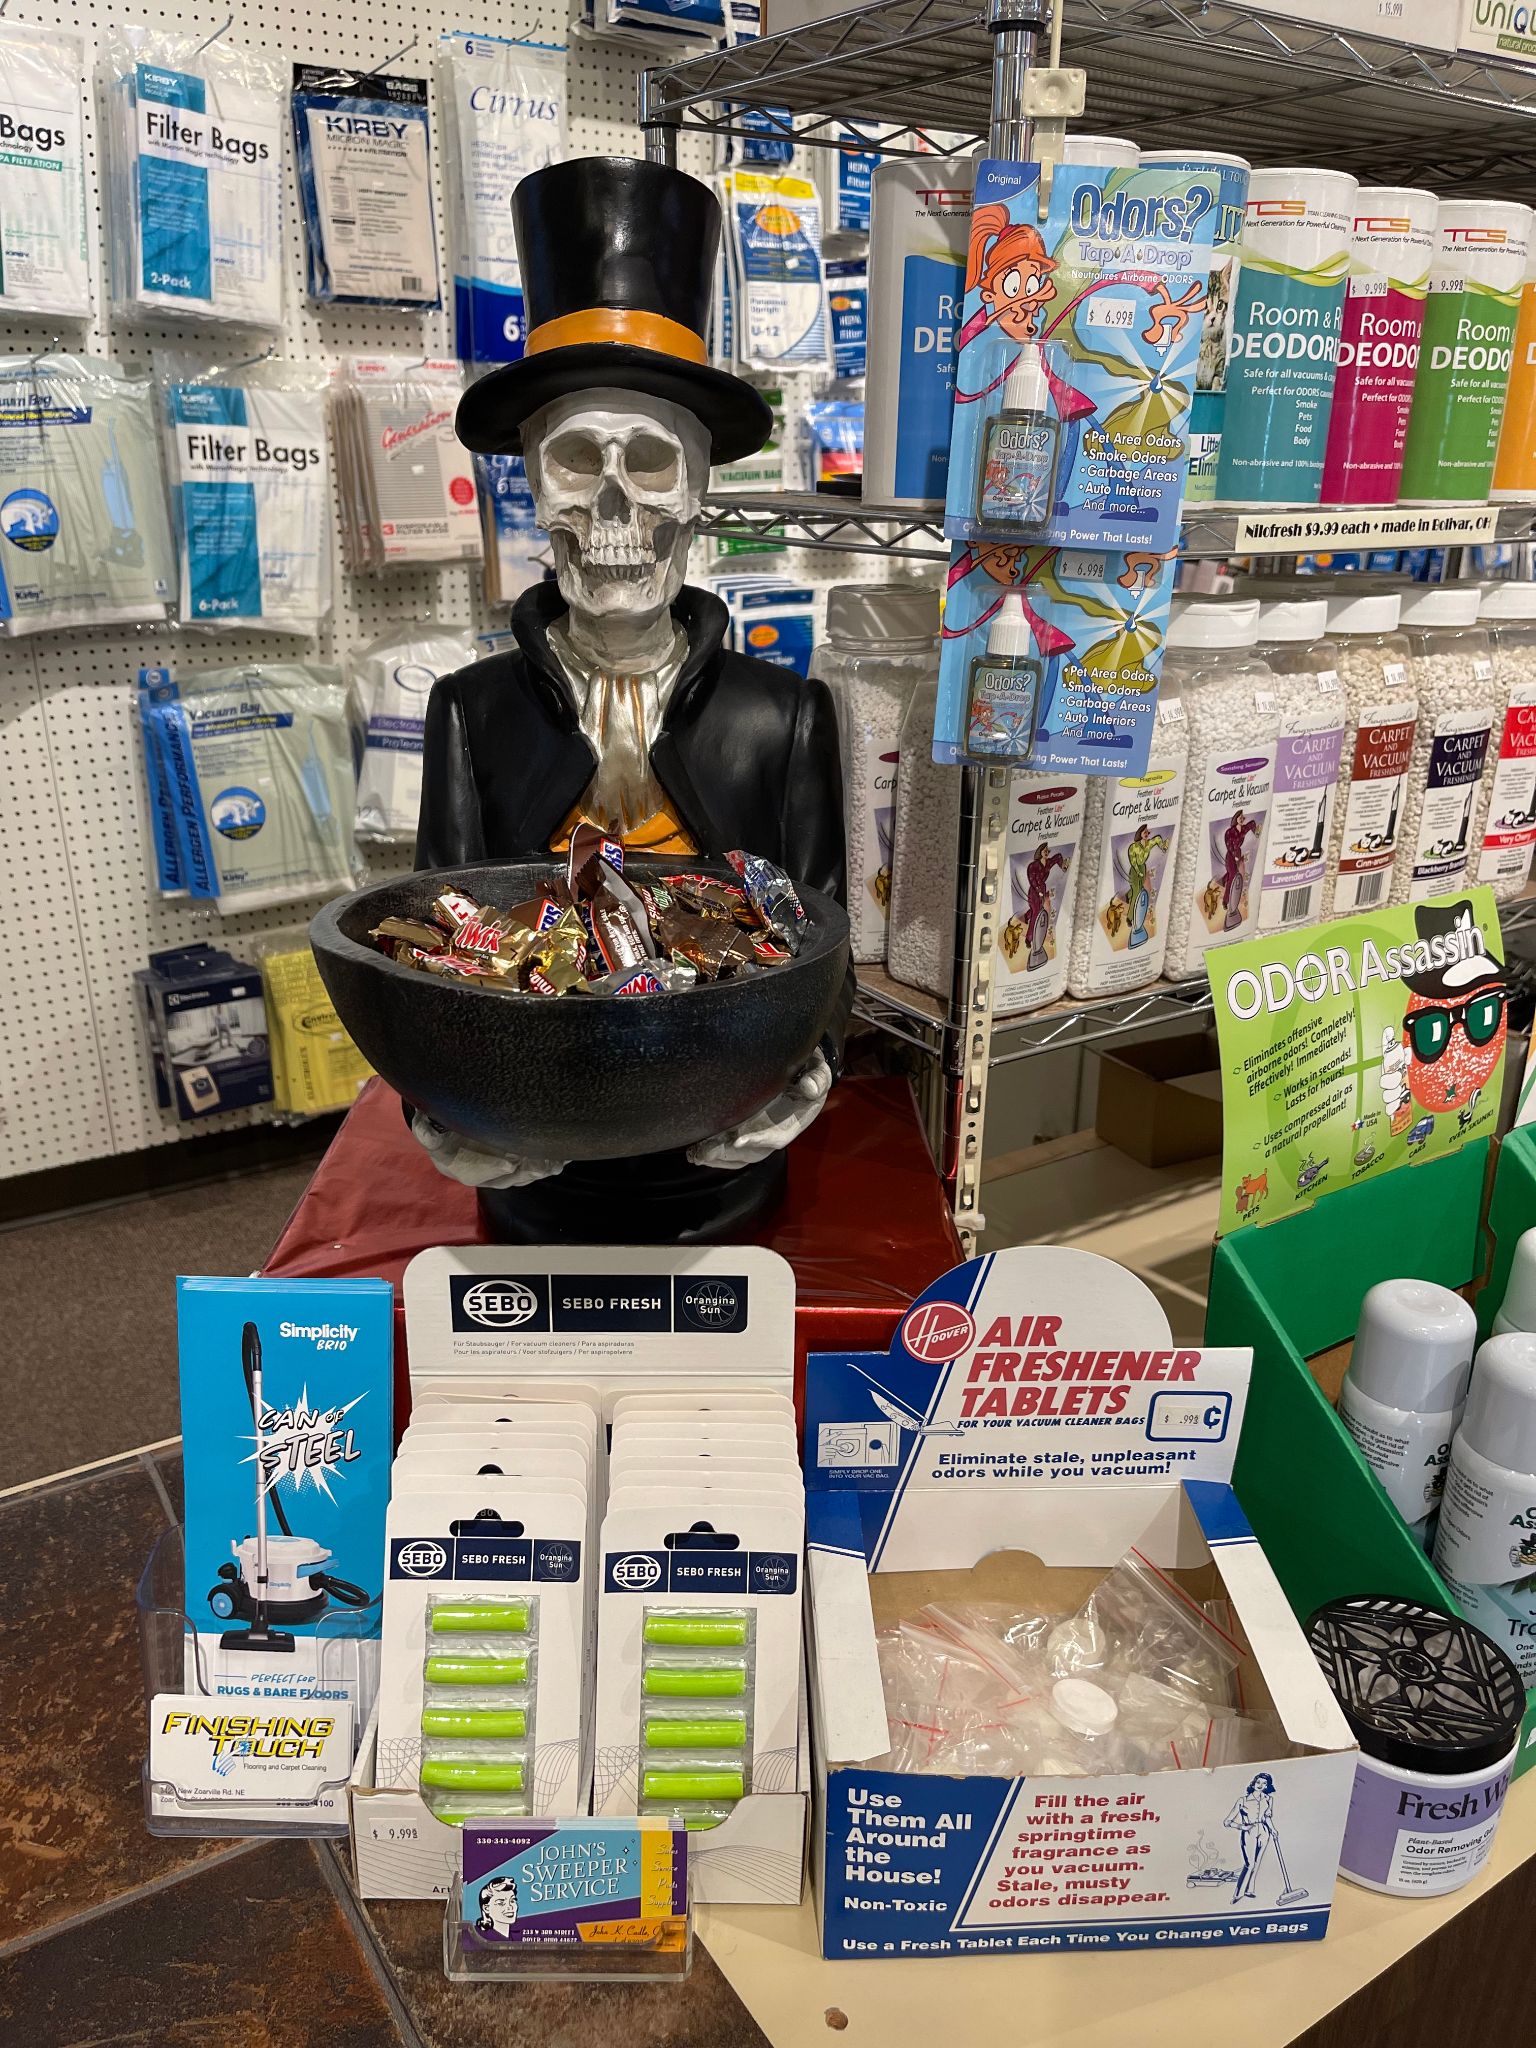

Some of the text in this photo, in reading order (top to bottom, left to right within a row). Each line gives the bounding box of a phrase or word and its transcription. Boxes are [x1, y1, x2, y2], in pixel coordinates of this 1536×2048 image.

[465, 41, 473, 54] 6
[144, 73, 178, 86] KIRBY
[470, 86, 559, 120] Cirrus
[0, 113, 66, 146] Bags
[325, 116, 408, 139] KIRBY
[147, 112, 202, 146] Filter
[212, 127, 269, 163] Bags
[12, 157, 62, 171] FILTRATION
[988, 173, 1021, 185] Original
[1071, 183, 1212, 243] Odors?
[150, 272, 192, 290] 2-Pack
[1072, 270, 1193, 284] Neutralizes Airborne ODORS
[1250, 302, 1331, 328] Room &
[1360, 313, 1416, 336] Room
[503, 315, 520, 339] 6
[1457, 319, 1510, 342] Room
[1244, 369, 1324, 380] Safe for all vacuums
[1296, 400, 1318, 408] Smoke
[1299, 412, 1312, 421] Pets
[1295, 424, 1312, 433] Food
[1000, 430, 1049, 451] Odors?
[1091, 432, 1182, 448] Pet Area Odors
[1294, 437, 1310, 446] Body
[188, 435, 320, 469] Filter Bags
[1089, 449, 1167, 464] Smoke Odors
[1088, 464, 1178, 482] Garbage Areas
[1085, 482, 1162, 498] Auto Interiors
[1244, 522, 1302, 538] Nilofresh
[1305, 521, 1339, 536] $9.99
[1341, 522, 1370, 536] each
[1381, 519, 1415, 534] made
[1418, 518, 1431, 532] in
[1476, 517, 1492, 530] OH
[199, 598, 238, 611] 6-Pack
[1443, 734, 1485, 753] CARPET
[1457, 751, 1471, 760] AND
[1436, 758, 1482, 777] VACUUM
[1112, 794, 1179, 819] Carpet & Vacuum
[1417, 862, 1449, 875] Blackberry
[1227, 909, 1487, 1019] ODOR Assassin
[1243, 1016, 1323, 1071] Eliminates offensive
[1247, 1008, 1356, 1084] airborne odors! Completely!
[1351, 1152, 1385, 1180] TOBACCO
[1295, 1174, 1328, 1200] KITCHEN
[1243, 1205, 1260, 1220] PETS
[468, 1295, 735, 1315] SEBO SEBO FRESH Orangina Sun
[280, 1322, 359, 1341] Simplicity
[978, 1316, 1063, 1348] AIR
[316, 1340, 348, 1351] BRIO
[967, 1351, 1202, 1383] FRESHENER
[960, 1385, 1132, 1418] TABLETS
[258, 1409, 344, 1431] CAN OF
[957, 1416, 1146, 1428] FOR YOUR VACUUM CLEANER BAGS
[259, 1430, 362, 1471] STEEL
[938, 1449, 1197, 1465] Eliminate stale, unpleasant
[931, 1461, 1171, 1479] odors while you vacuum!
[251, 1674, 316, 1684] PERFECT FOR
[217, 1685, 349, 1700] RUGS & BARE FLOORS
[162, 1712, 336, 1737] FINISHING
[209, 1735, 325, 1758] TOUCH
[243, 1763, 327, 1772] Flooring and Carpet Cleaning
[847, 1788, 902, 1809] Use
[1034, 1792, 1146, 1809] Fill the air
[1396, 1790, 1478, 1820] Fresh
[846, 1807, 972, 1831] Them All
[1026, 1808, 1161, 1825] with a fresh,
[845, 1826, 947, 1849] Around
[1017, 1827, 1137, 1844] springtime
[1408, 1837, 1453, 1845] Plant-Based
[845, 1845, 891, 1865] the
[1012, 1843, 1151, 1861] fragrance as
[1406, 1836, 1483, 1855] Odor Removing
[522, 1858, 630, 1883] SWEEPER
[845, 1864, 941, 1885] House!
[1004, 1860, 1144, 1878] you vacuum.
[530, 1878, 620, 1902] SERVICE
[997, 1876, 1131, 1895] Stale, musty
[844, 1896, 948, 1913] Non-Toxic
[989, 1890, 1171, 1910] odors disappear.
[842, 1921, 1309, 1952] Use a Fresh Tablet Each Time You Change Vac Bags
